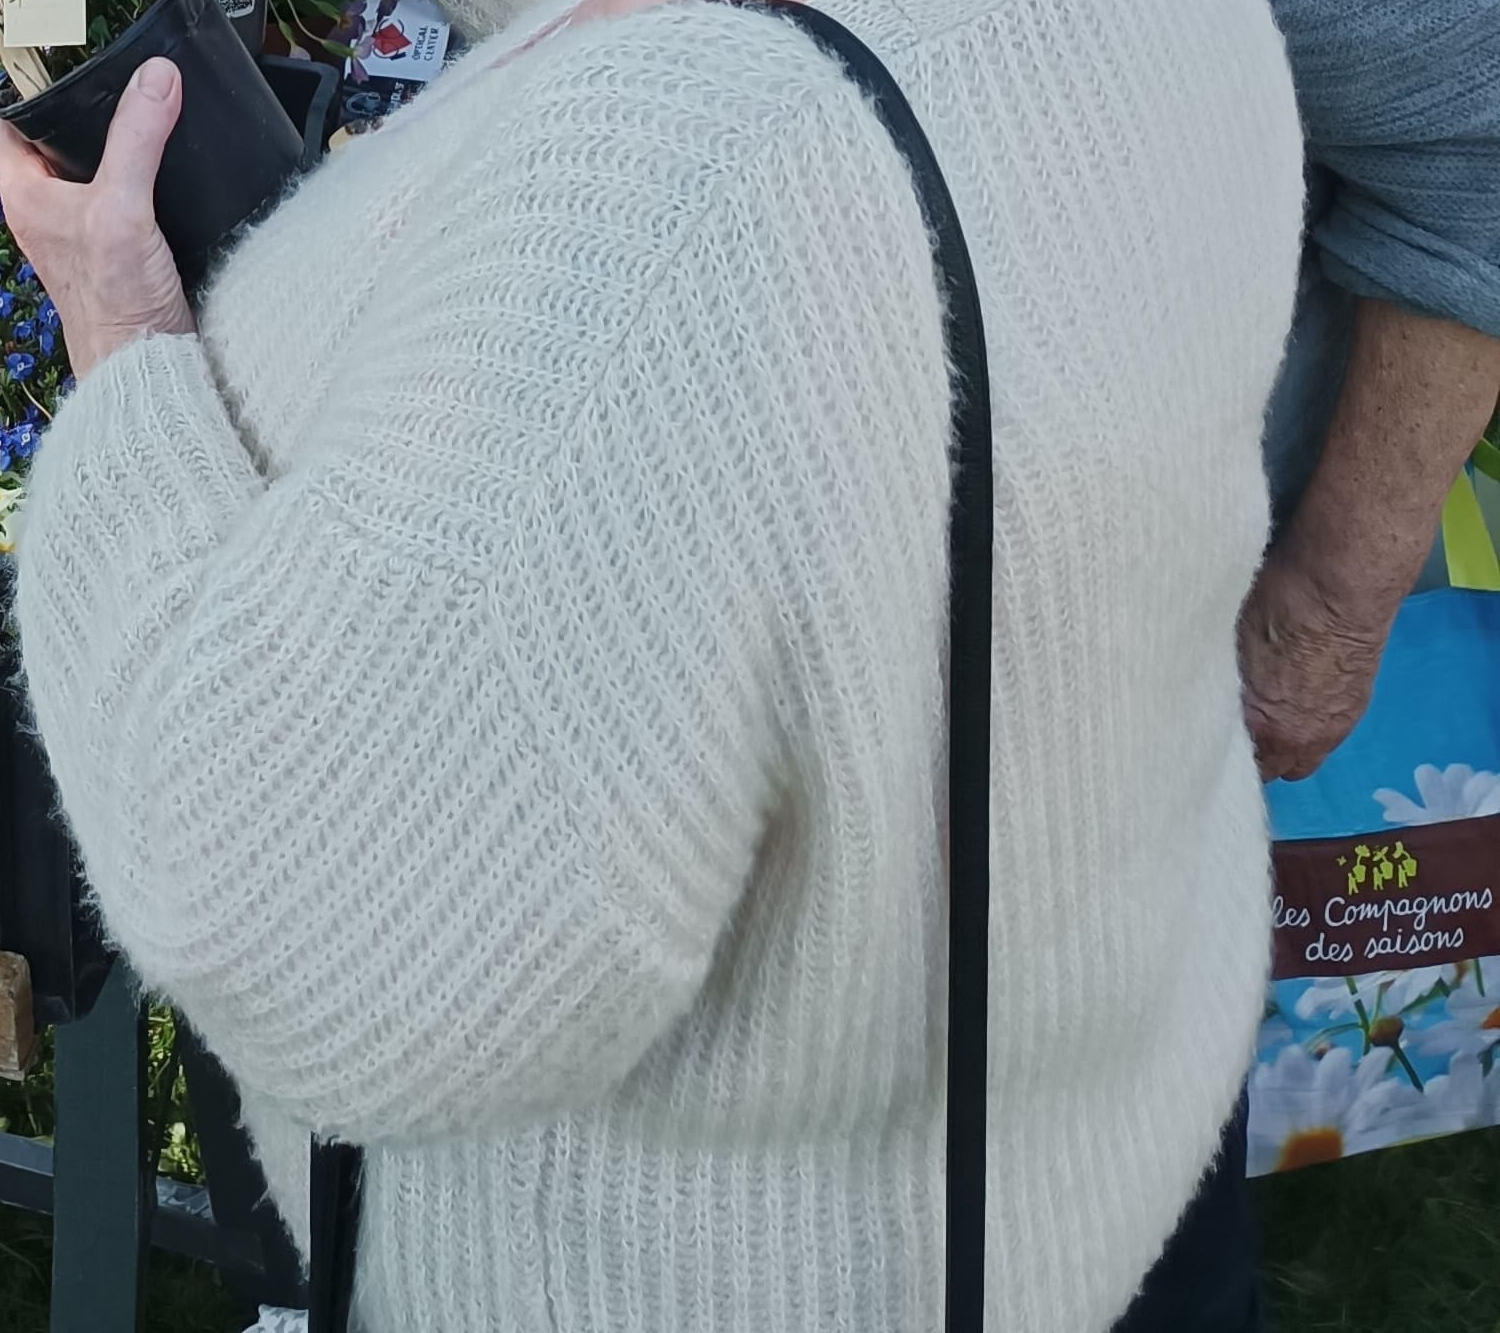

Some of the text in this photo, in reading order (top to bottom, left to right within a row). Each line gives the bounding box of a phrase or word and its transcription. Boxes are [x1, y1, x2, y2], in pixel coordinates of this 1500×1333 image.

[411, 27, 426, 62] OPTICAL
[425, 27, 440, 61] CENTER
[1272, 887, 1493, 932] les Compagnons
[1305, 927, 1464, 962] des saisons
